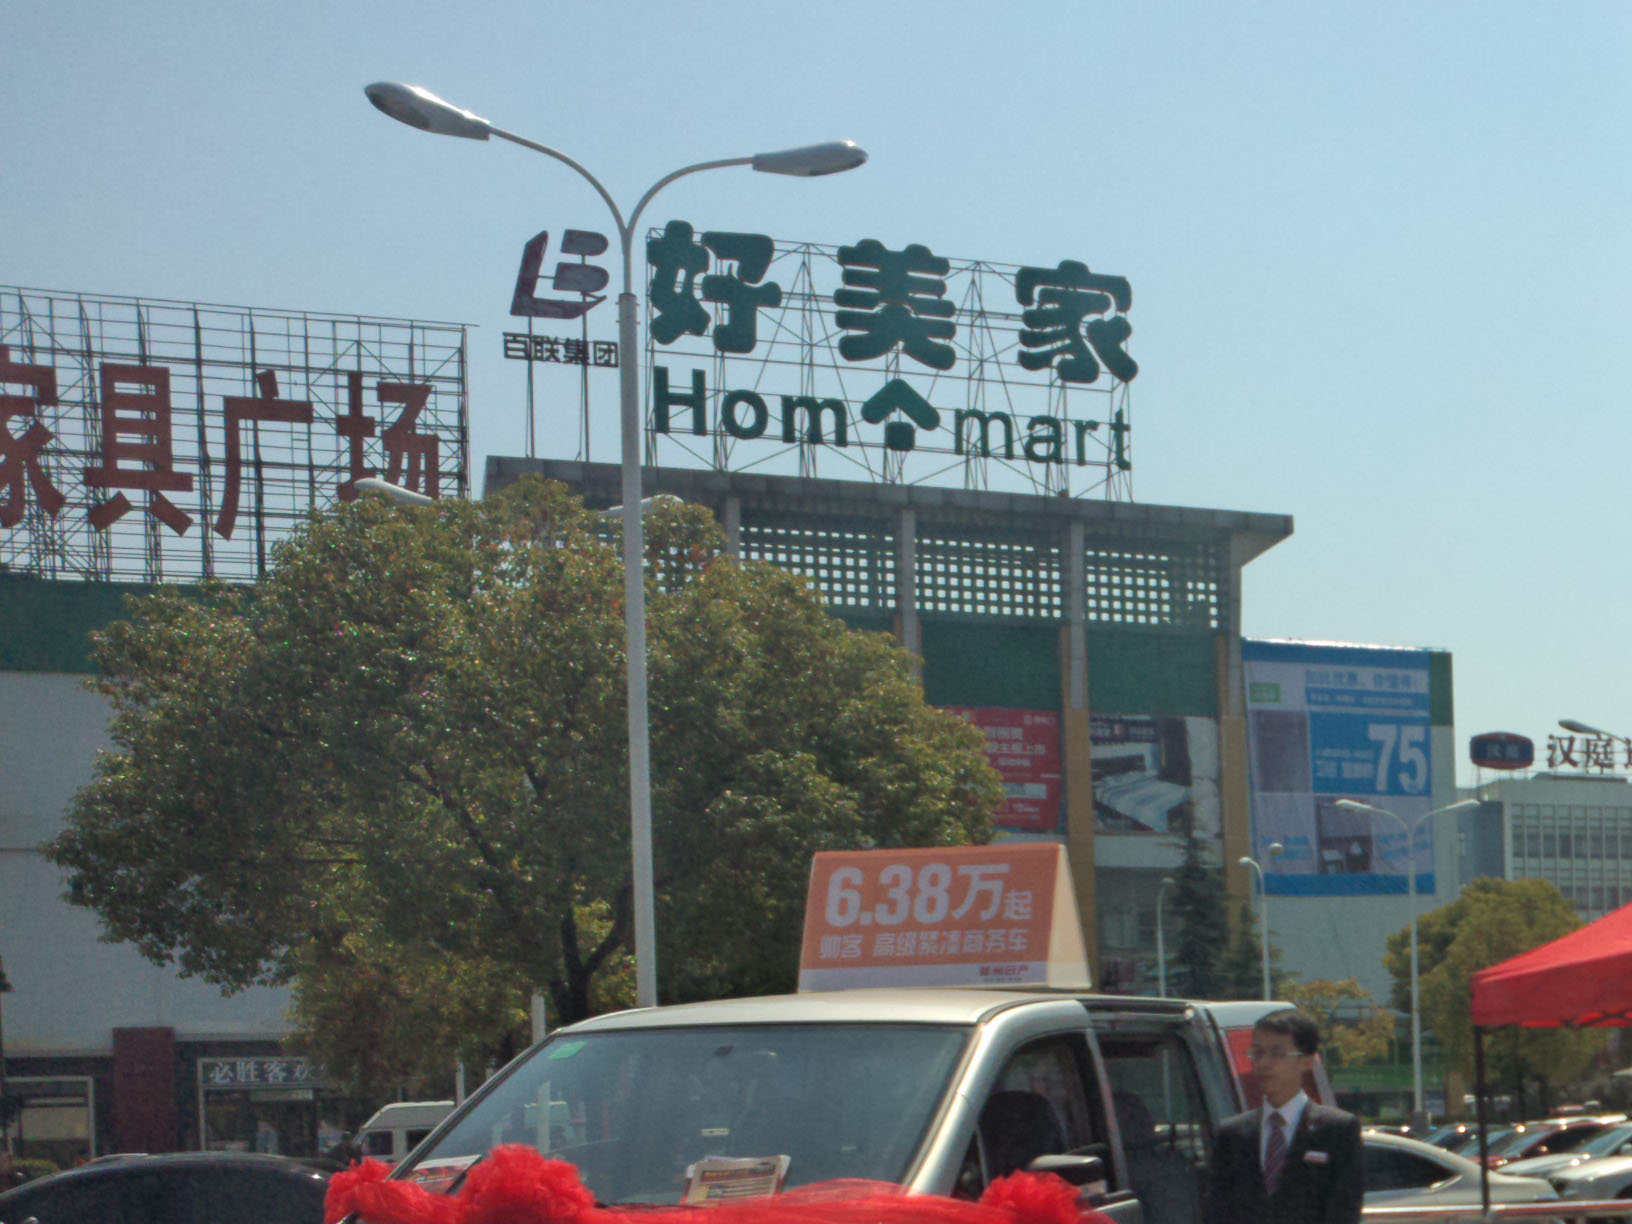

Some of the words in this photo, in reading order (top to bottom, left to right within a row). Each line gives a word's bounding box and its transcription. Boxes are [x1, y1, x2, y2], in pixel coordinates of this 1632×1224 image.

[645, 219, 1139, 384] 好美家
[502, 332, 619, 368] 百联集团
[1368, 723, 1428, 794] 75
[825, 863, 1033, 927] 6.38万起
